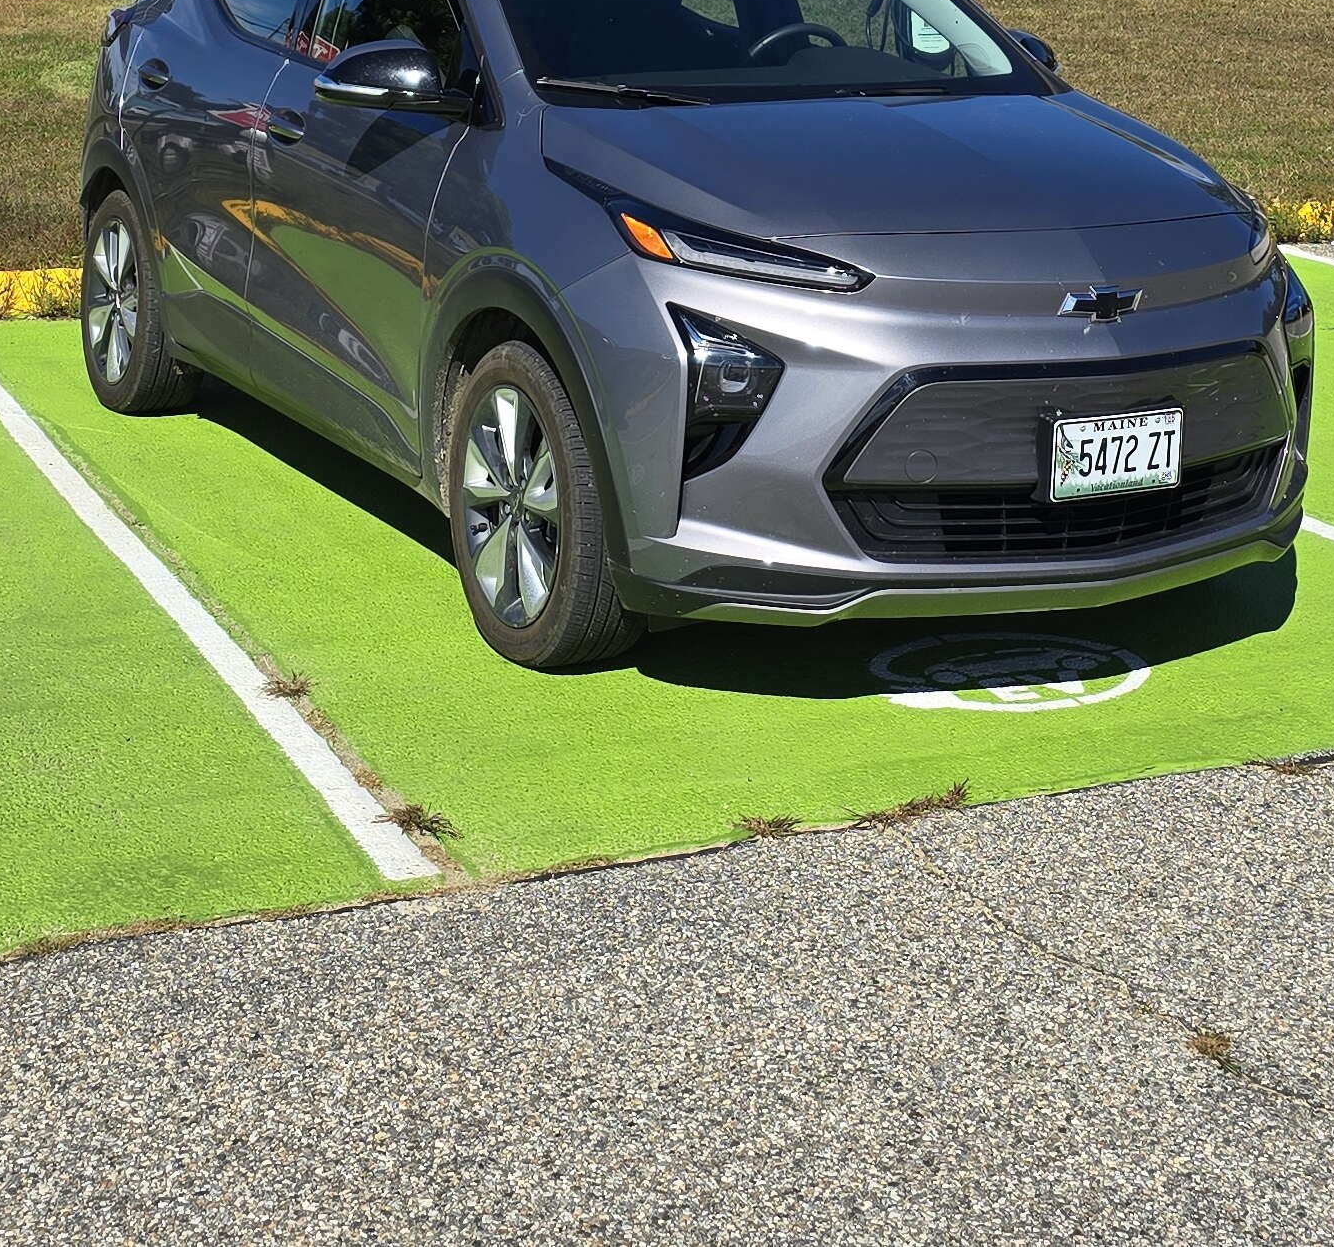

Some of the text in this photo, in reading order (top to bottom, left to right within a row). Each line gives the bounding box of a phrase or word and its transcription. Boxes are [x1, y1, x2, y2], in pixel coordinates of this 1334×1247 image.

[1094, 417, 1148, 432] MAINE
[1079, 430, 1176, 477] 5472 ZT
[1091, 478, 1143, 492] Vacationland
[979, 670, 1085, 702] EV
